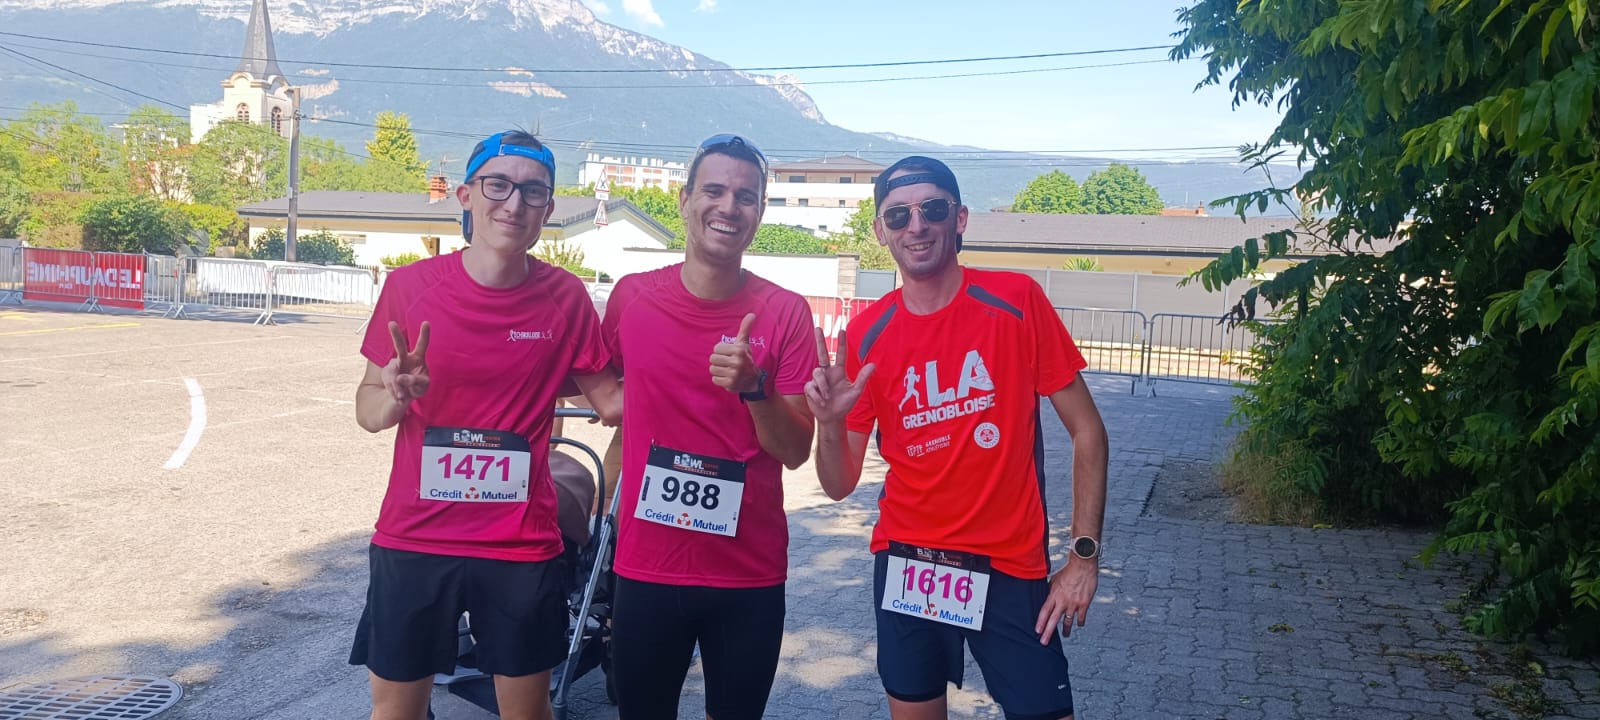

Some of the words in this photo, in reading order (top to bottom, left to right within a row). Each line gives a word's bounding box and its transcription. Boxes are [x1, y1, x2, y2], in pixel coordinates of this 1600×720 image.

[925, 349, 995, 407] LA
[902, 393, 996, 430] GRENOBLOISE
[437, 453, 511, 482] 1471
[430, 488, 463, 499] Crédit
[481, 490, 518, 500] Mutuel
[661, 476, 721, 511] 988
[644, 508, 675, 523] Crédit
[692, 518, 728, 533] Mutuel
[902, 564, 974, 603] 1616
[892, 599, 923, 614] Crédit
[939, 609, 974, 625] Mutuel
